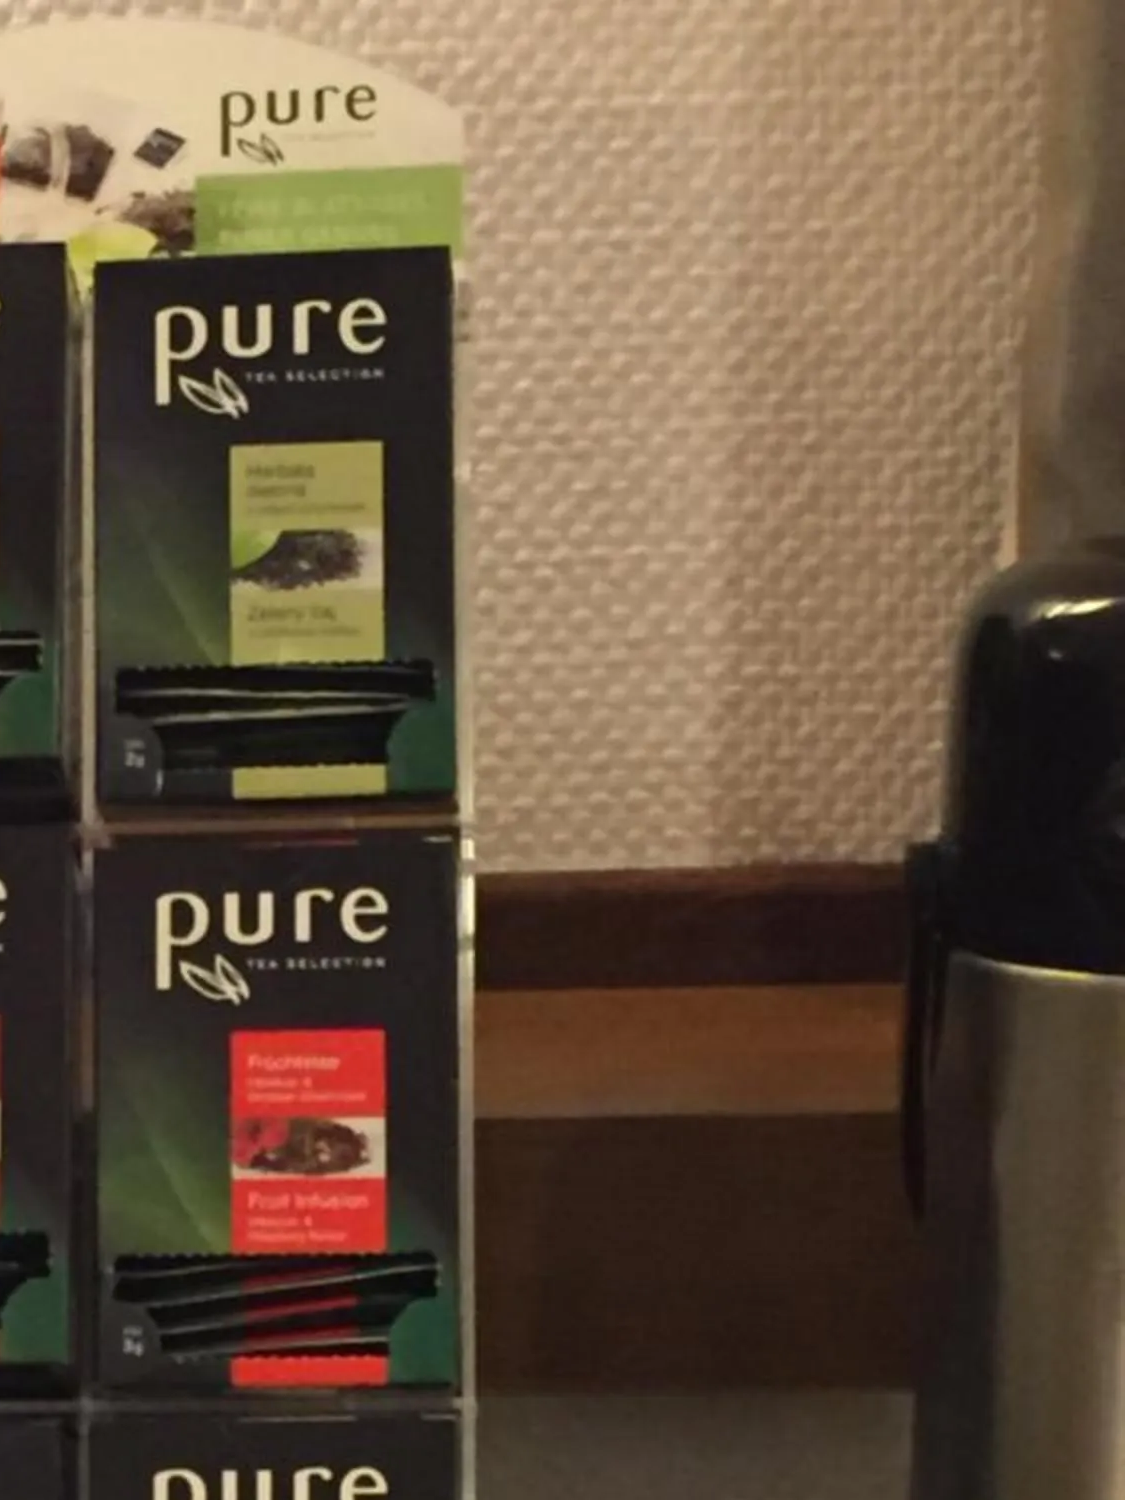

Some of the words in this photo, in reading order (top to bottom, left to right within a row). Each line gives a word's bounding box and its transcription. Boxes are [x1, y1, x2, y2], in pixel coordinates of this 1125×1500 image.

[221, 84, 377, 157] pure
[155, 298, 387, 406] pure
[245, 371, 276, 383] TEA
[285, 368, 385, 382] SELECTION
[156, 887, 389, 990] pure
[246, 958, 279, 970] TEA
[286, 957, 387, 970] SELECTION
